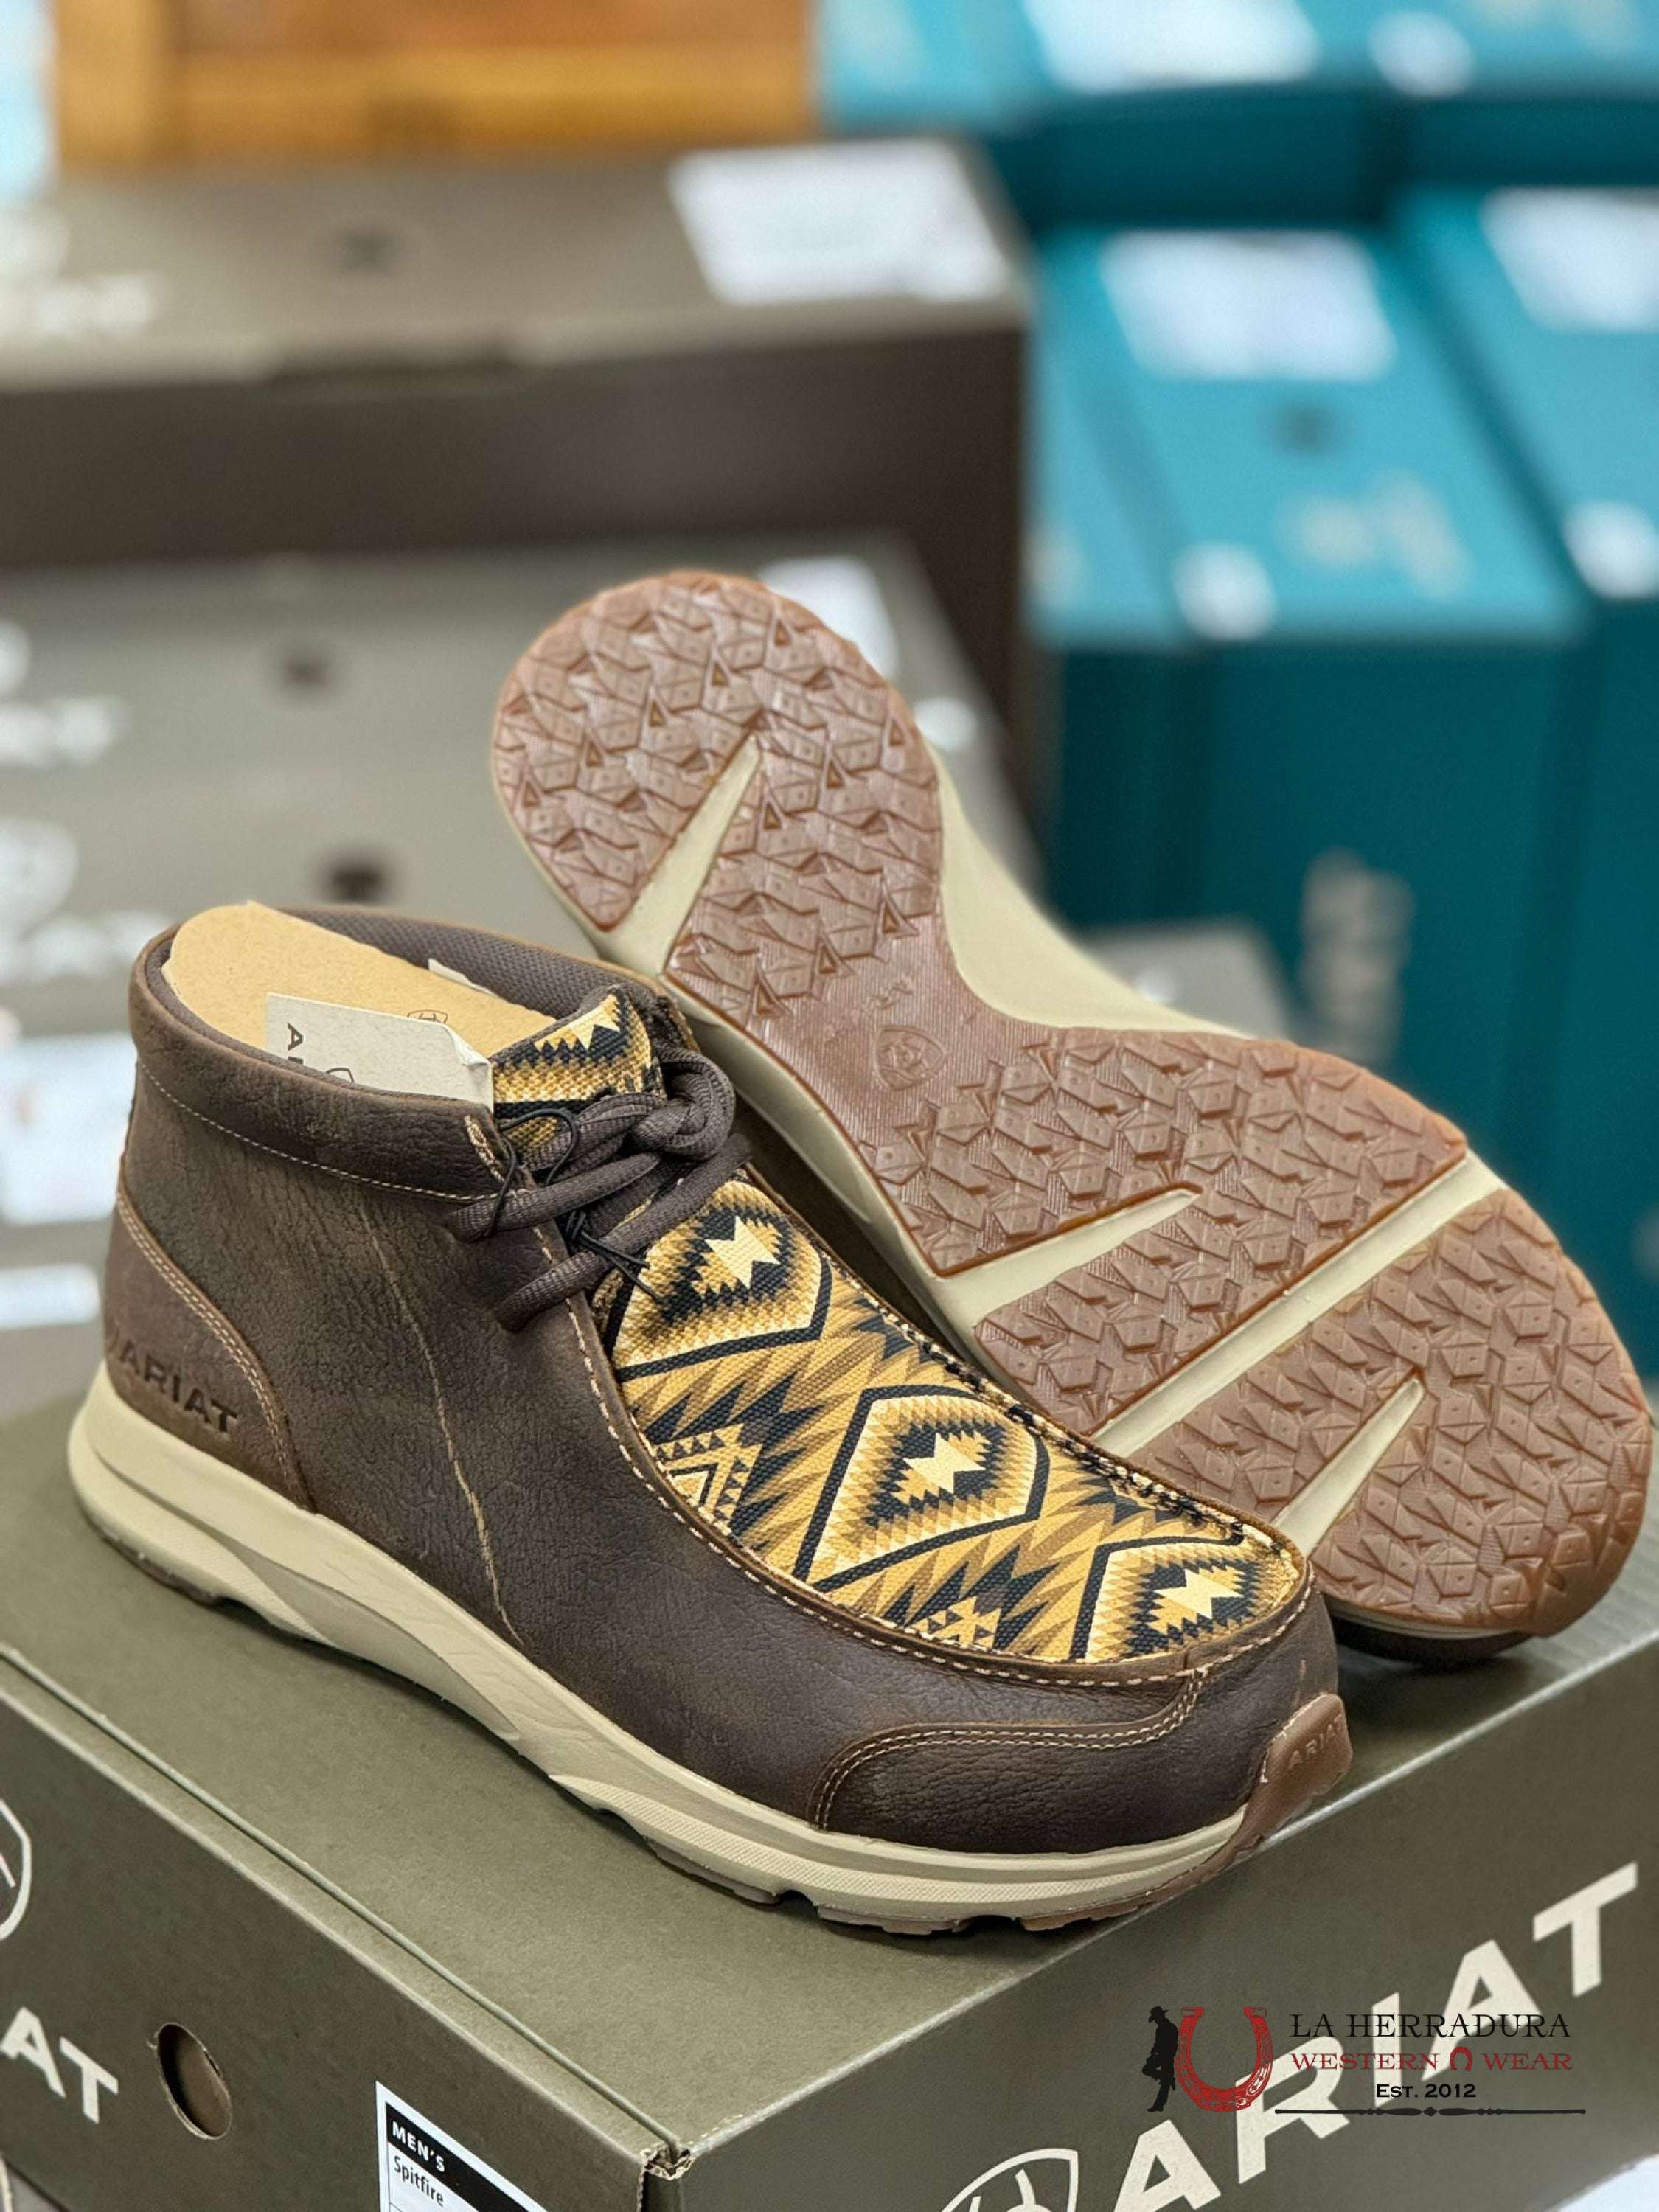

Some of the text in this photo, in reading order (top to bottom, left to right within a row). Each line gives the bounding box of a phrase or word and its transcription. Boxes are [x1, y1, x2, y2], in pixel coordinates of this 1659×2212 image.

[119, 1339, 237, 1433] ARIAT
[1112, 1860, 1638, 2212] ARIAT
[392, 2121, 445, 2173] MEN'S
[394, 2156, 444, 2207] Spitfire
